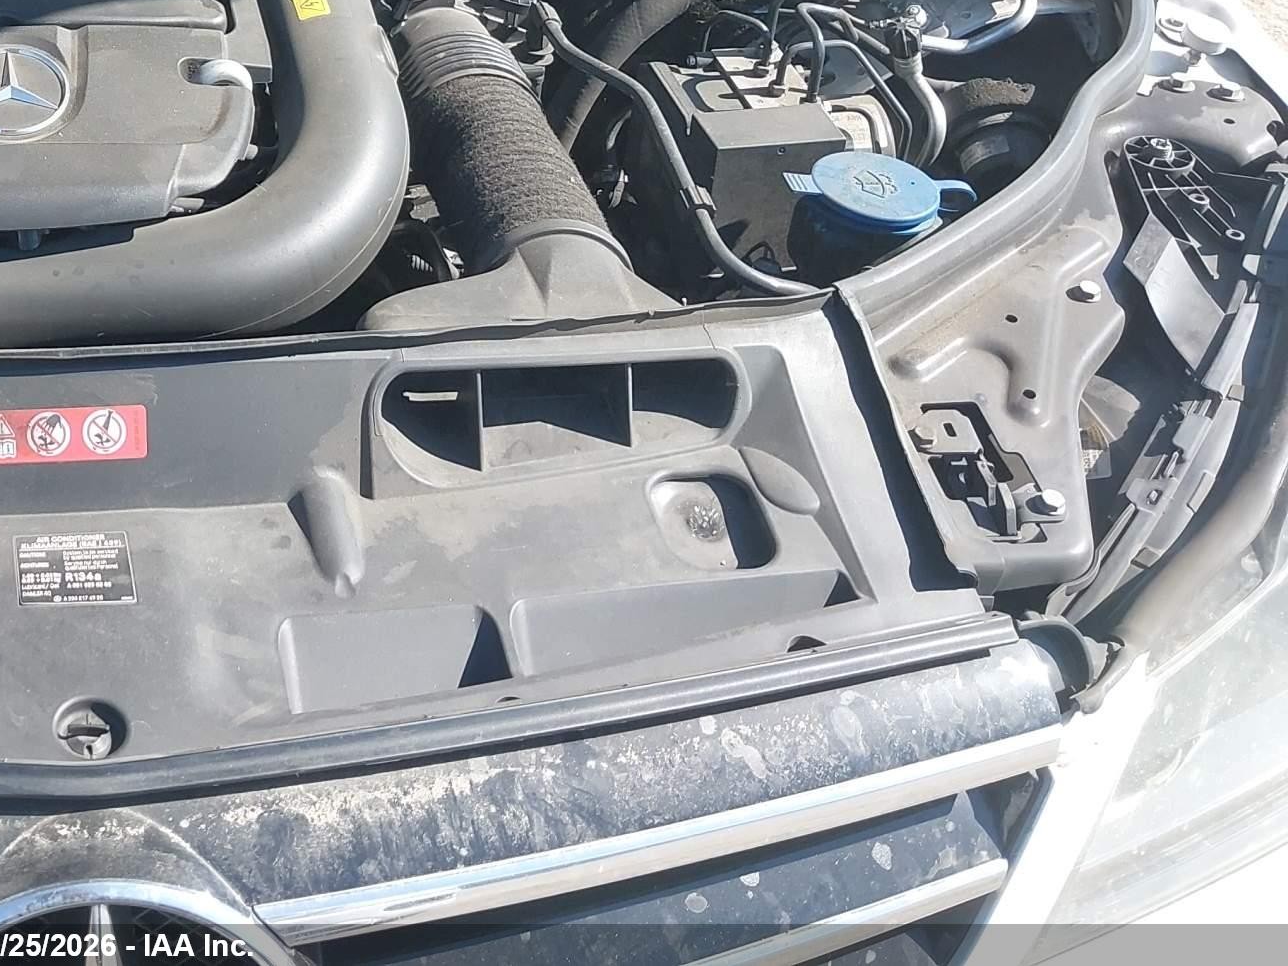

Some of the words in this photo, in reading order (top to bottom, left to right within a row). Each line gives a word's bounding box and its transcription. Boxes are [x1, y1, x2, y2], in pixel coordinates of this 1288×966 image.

[51, 534, 105, 542] CONDITIONER
[21, 541, 77, 549] KLIMAANLAGE
[65, 572, 102, 581] R134a
